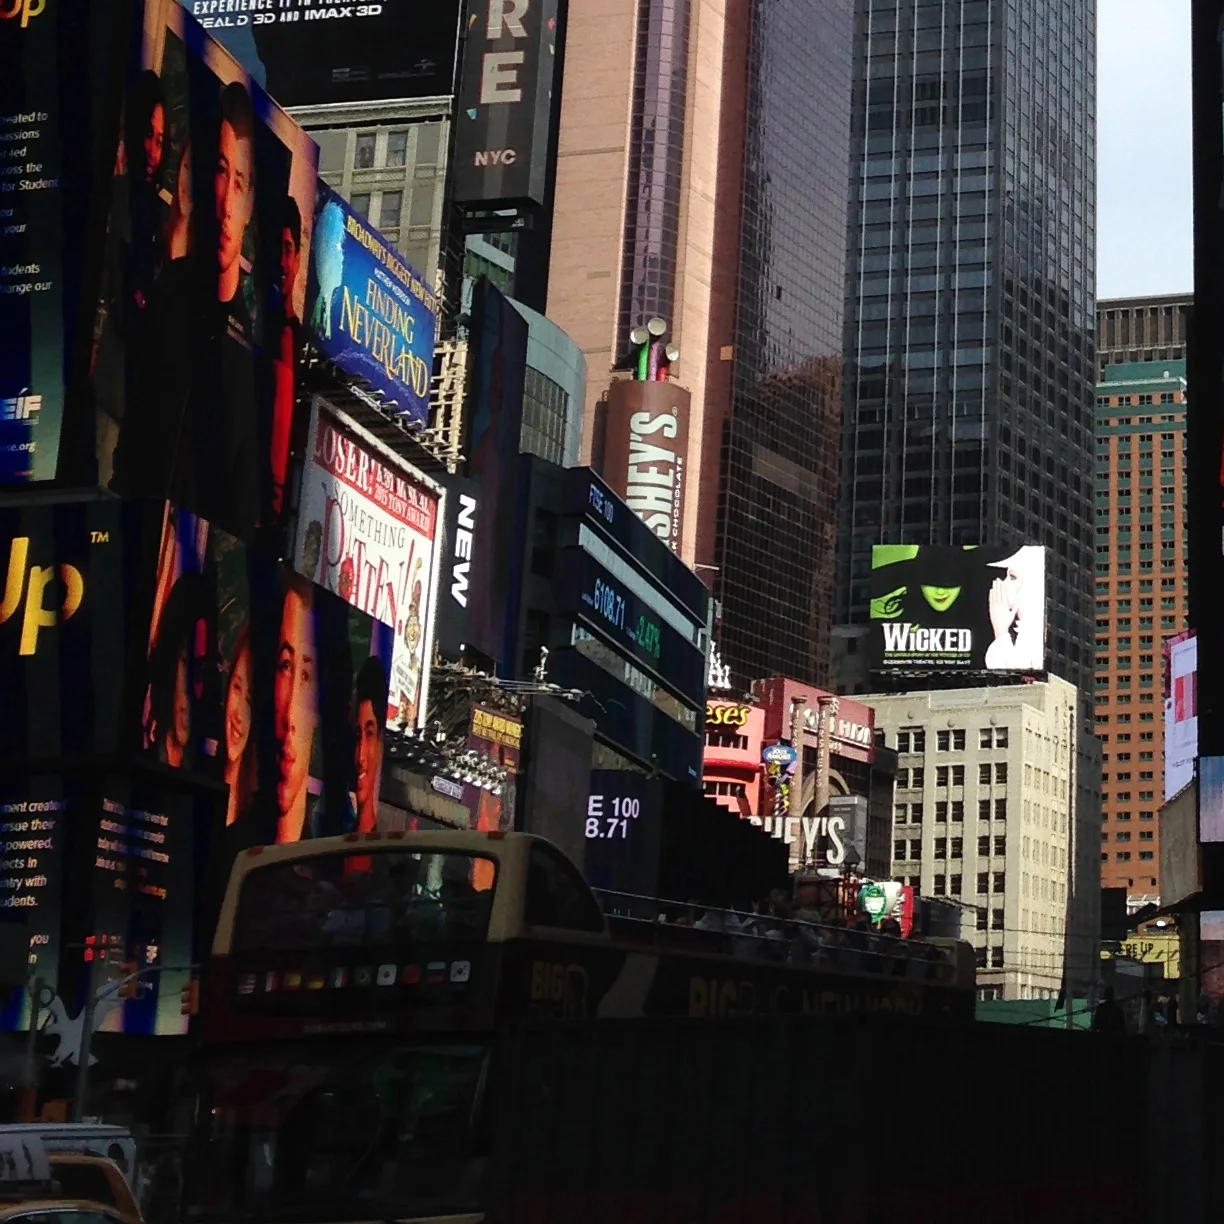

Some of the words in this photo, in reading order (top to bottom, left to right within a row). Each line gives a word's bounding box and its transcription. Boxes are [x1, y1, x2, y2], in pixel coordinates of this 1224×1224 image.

[253, 12, 276, 25] 3D
[280, 11, 300, 22] AND
[304, 7, 352, 21] IMAX
[355, 4, 382, 17] 3D
[474, 148, 517, 167] NYC
[338, 285, 429, 399] NEVERLAND
[365, 278, 414, 344] FINDING
[314, 425, 376, 494] LOSER!
[626, 411, 678, 544] SHEY'S
[334, 481, 405, 549] SOMETHING
[451, 494, 476, 608] NEW
[594, 578, 626, 630] 6108.71
[585, 817, 628, 839] 8.71
[588, 795, 604, 816] E
[612, 797, 640, 818] 100
